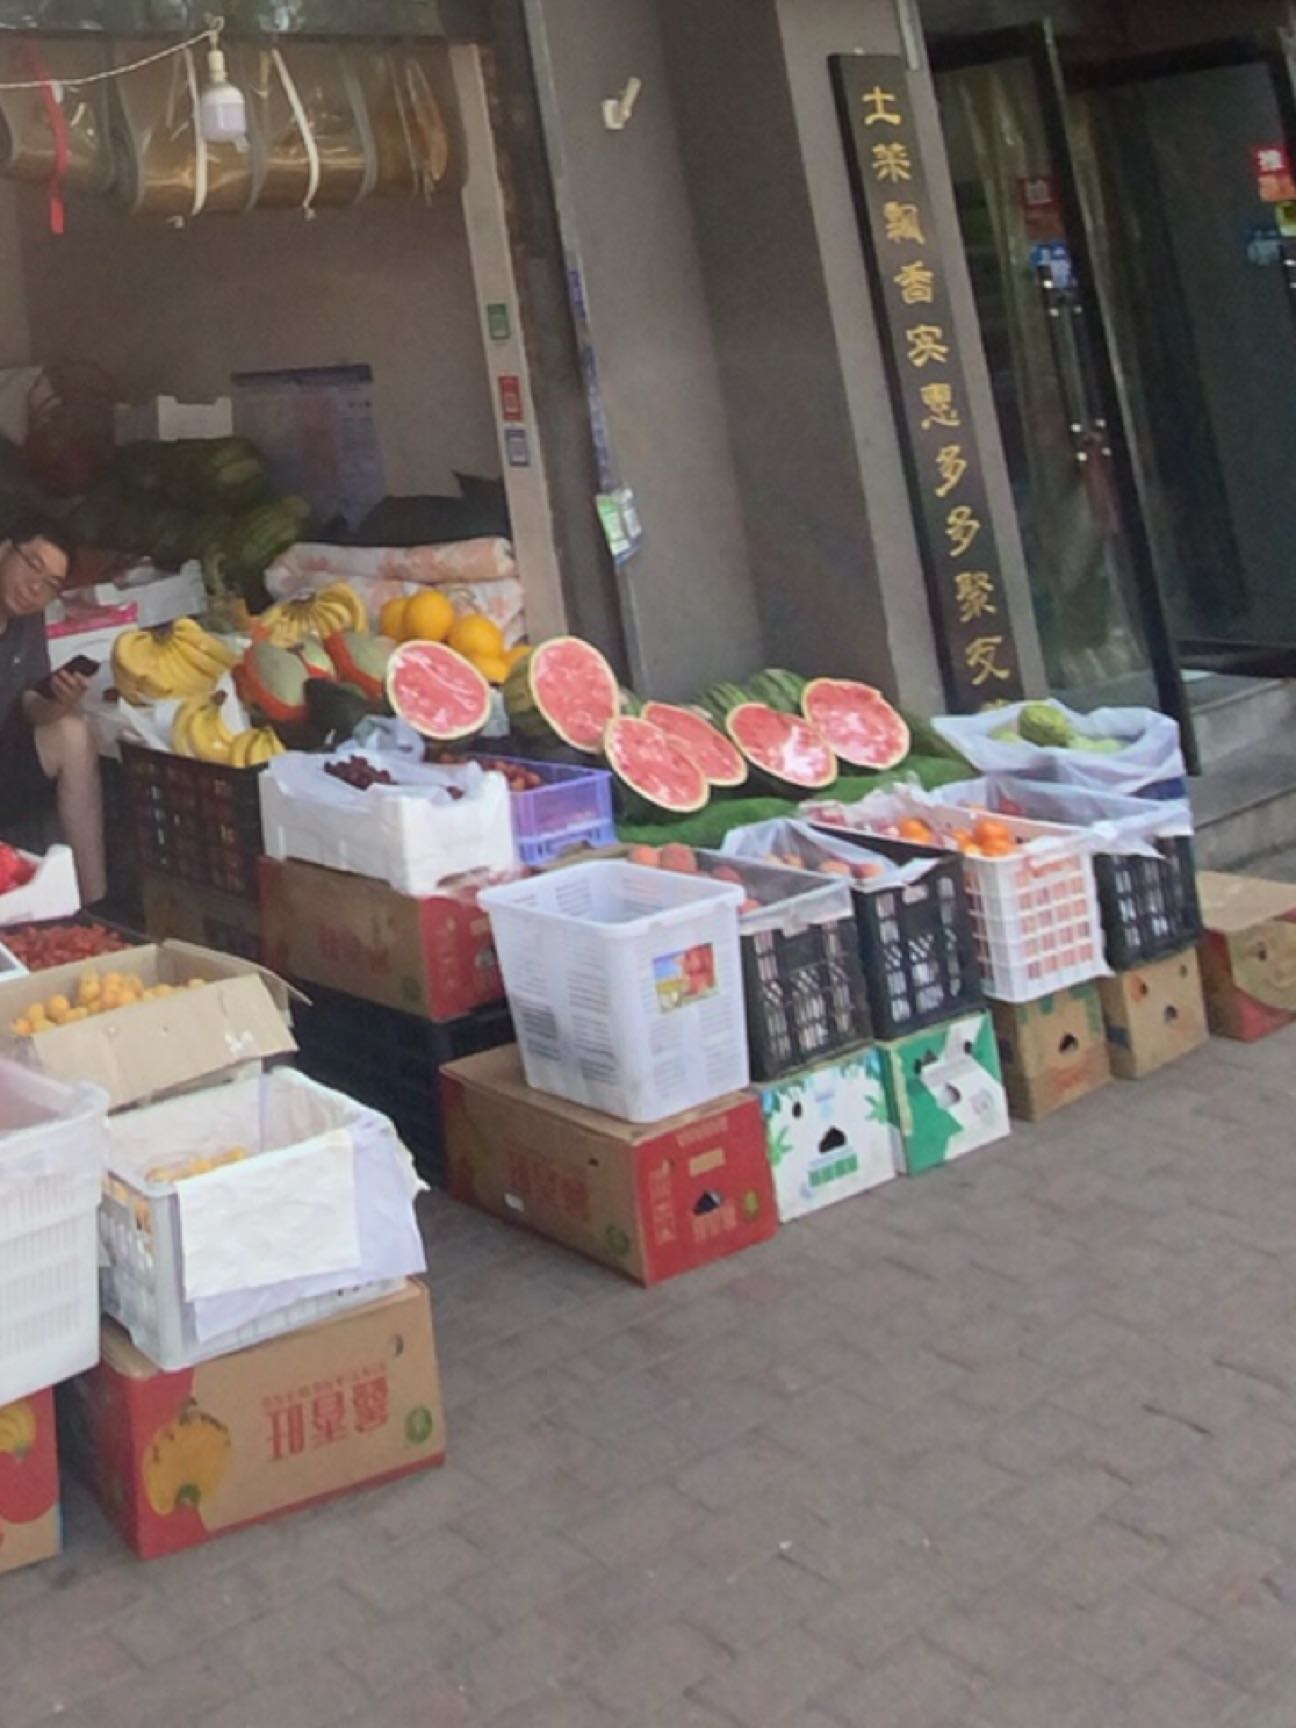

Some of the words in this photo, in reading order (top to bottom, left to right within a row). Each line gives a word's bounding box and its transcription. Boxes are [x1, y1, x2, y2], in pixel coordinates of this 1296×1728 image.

[861, 85, 1012, 710] 土菜飘香实惠多多聚友
